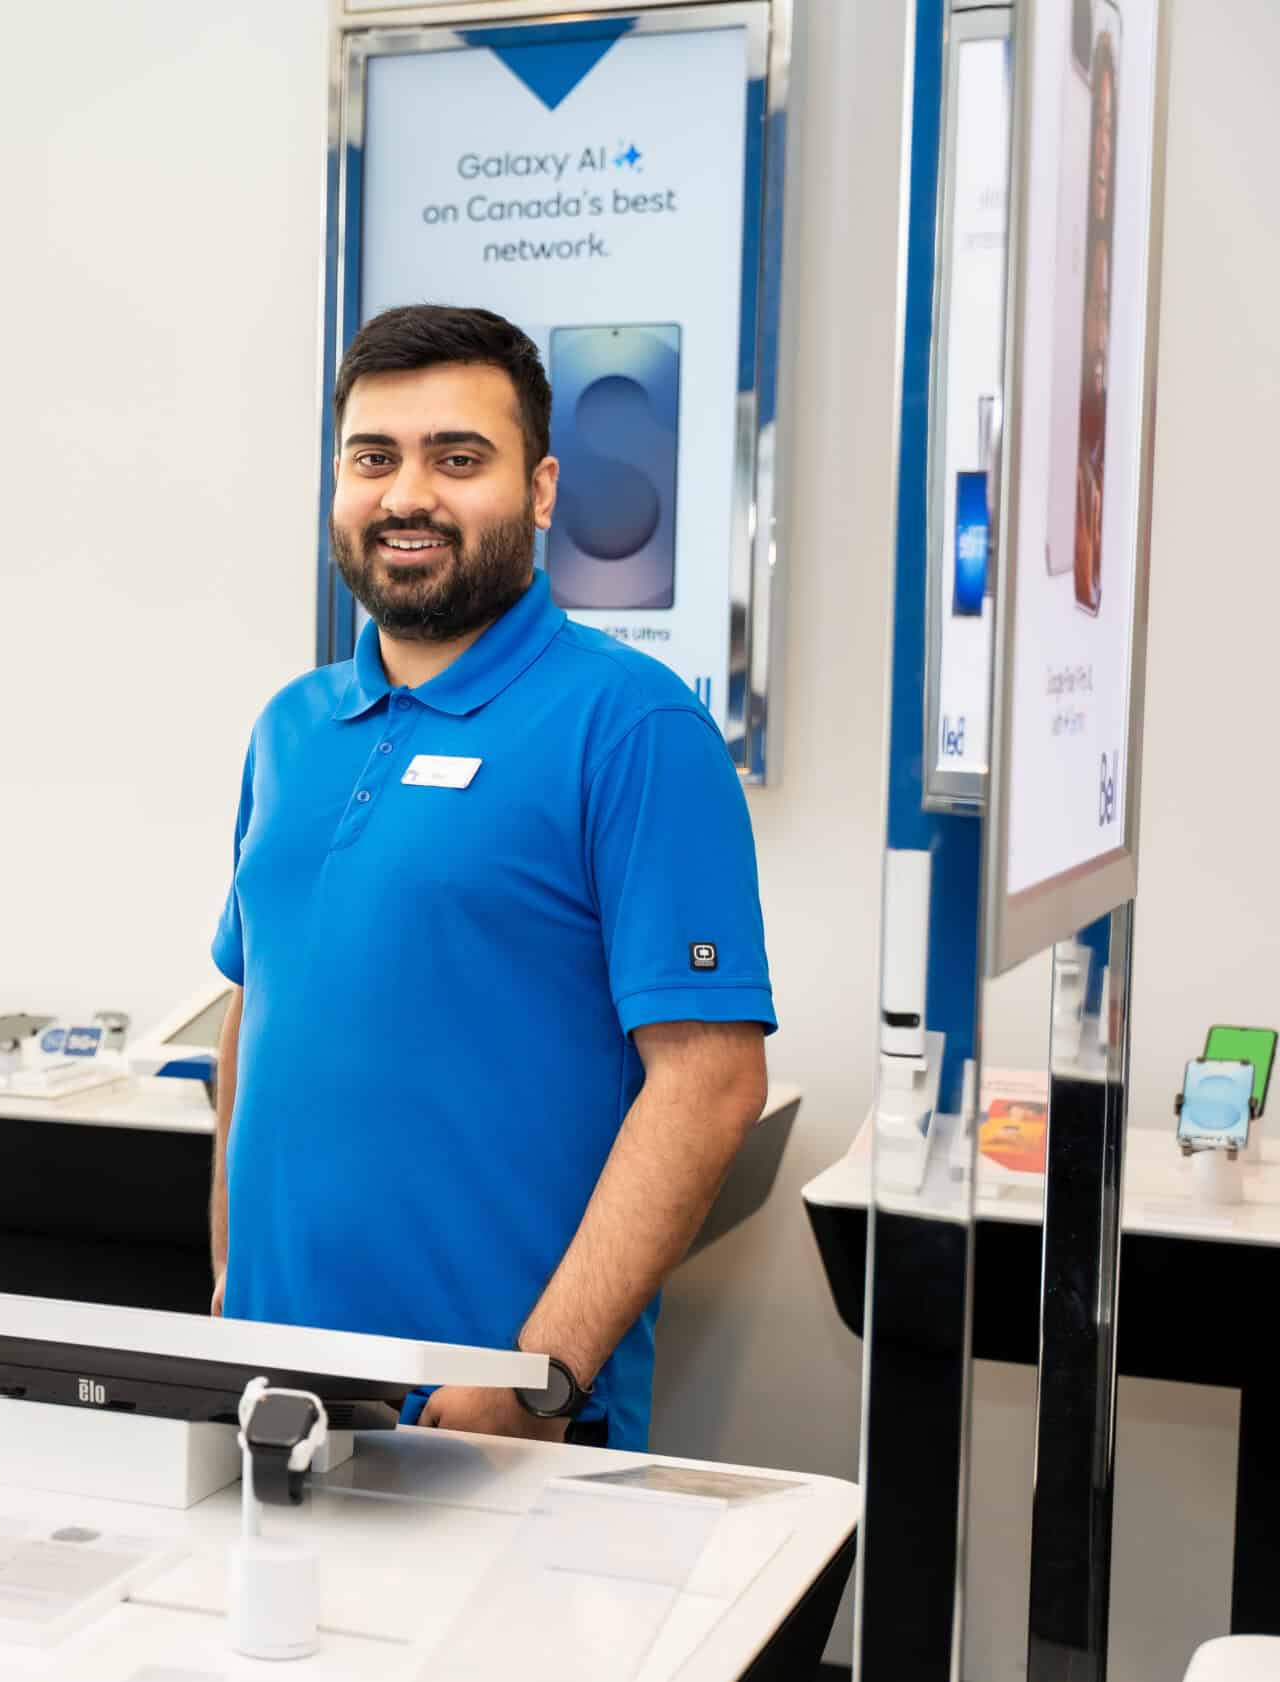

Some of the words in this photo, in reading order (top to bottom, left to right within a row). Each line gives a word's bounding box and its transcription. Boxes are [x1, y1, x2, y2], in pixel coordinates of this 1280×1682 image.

[457, 150, 570, 183] Galaxy
[578, 147, 606, 172] AI
[422, 203, 459, 226] on
[466, 190, 603, 223] Canada's
[612, 187, 677, 215] best
[483, 233, 610, 264] network.
